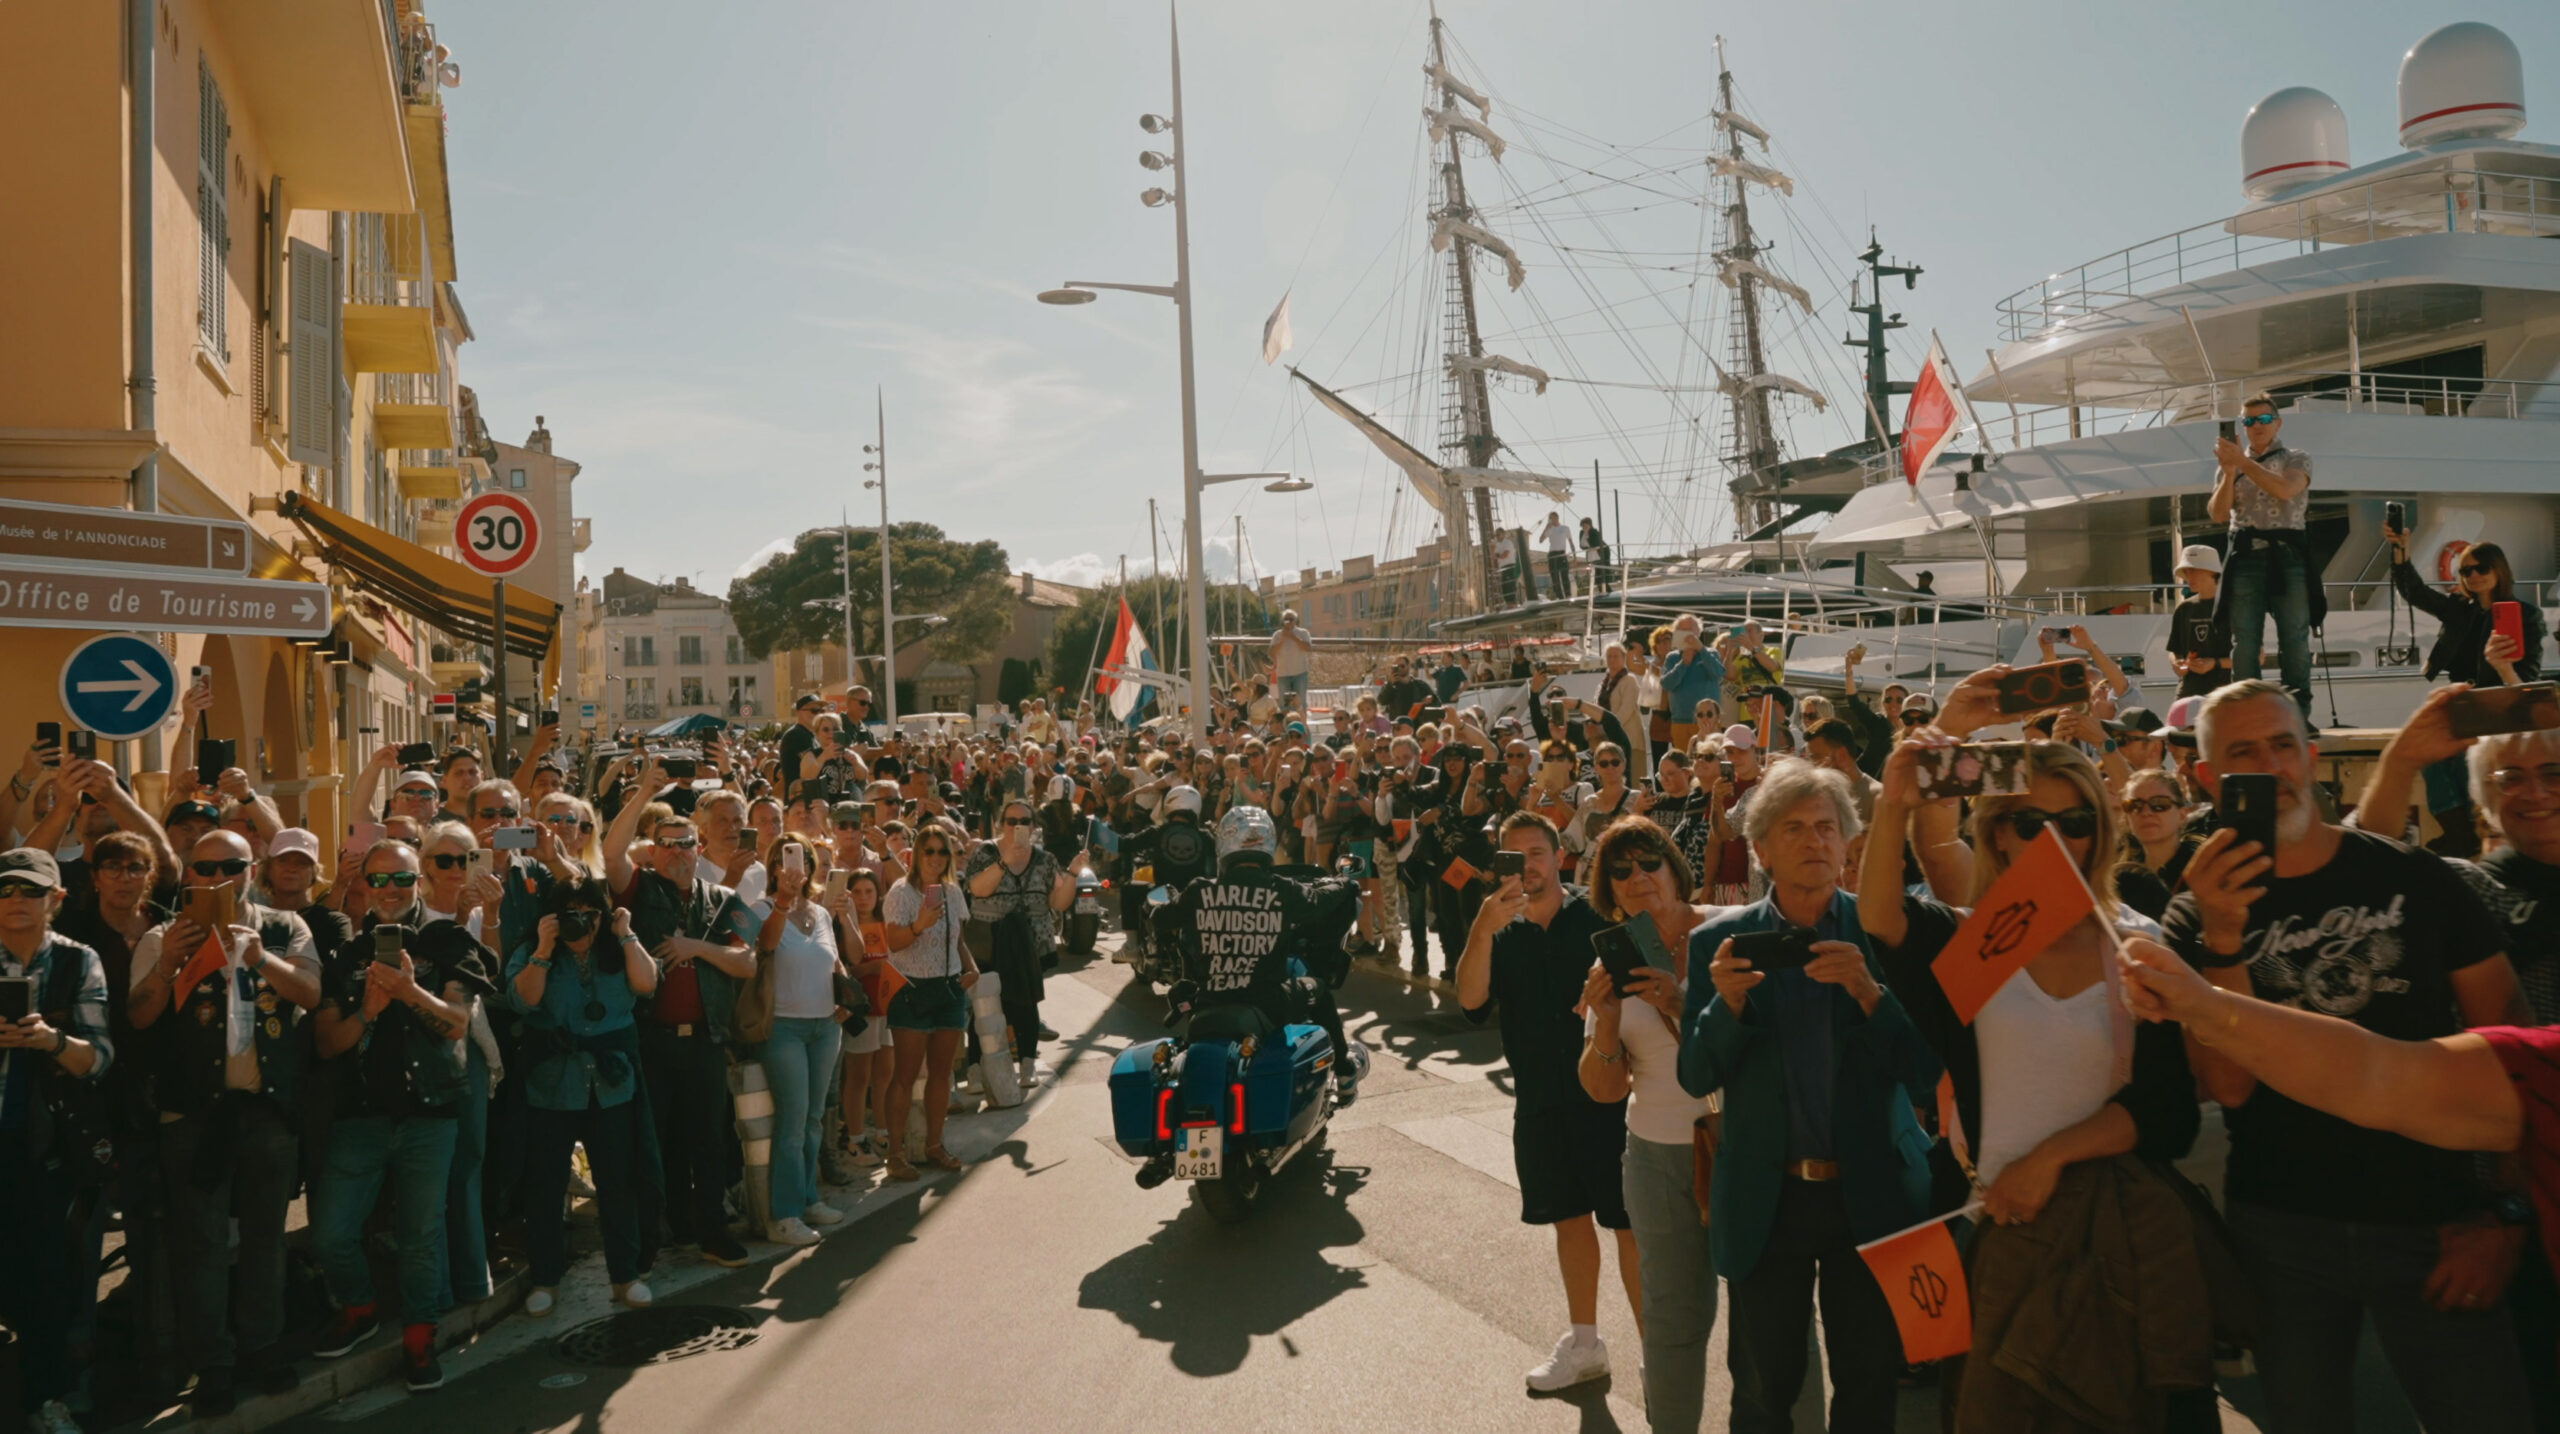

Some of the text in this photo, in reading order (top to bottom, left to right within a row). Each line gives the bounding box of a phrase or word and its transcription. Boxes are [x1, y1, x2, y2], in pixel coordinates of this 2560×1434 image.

[42, 528, 58, 541] de
[473, 515, 523, 551] 30
[0, 580, 276, 620] Office de Tourisme
[1200, 885, 1282, 910] HARLEY-
[1196, 909, 1283, 933] DAVIDSON
[2318, 894, 2405, 960] York
[1201, 933, 1278, 955] FACTORY
[1209, 955, 1259, 975] RACE
[1207, 975, 1251, 991] TEAM
[1199, 1129, 1208, 1144] F
